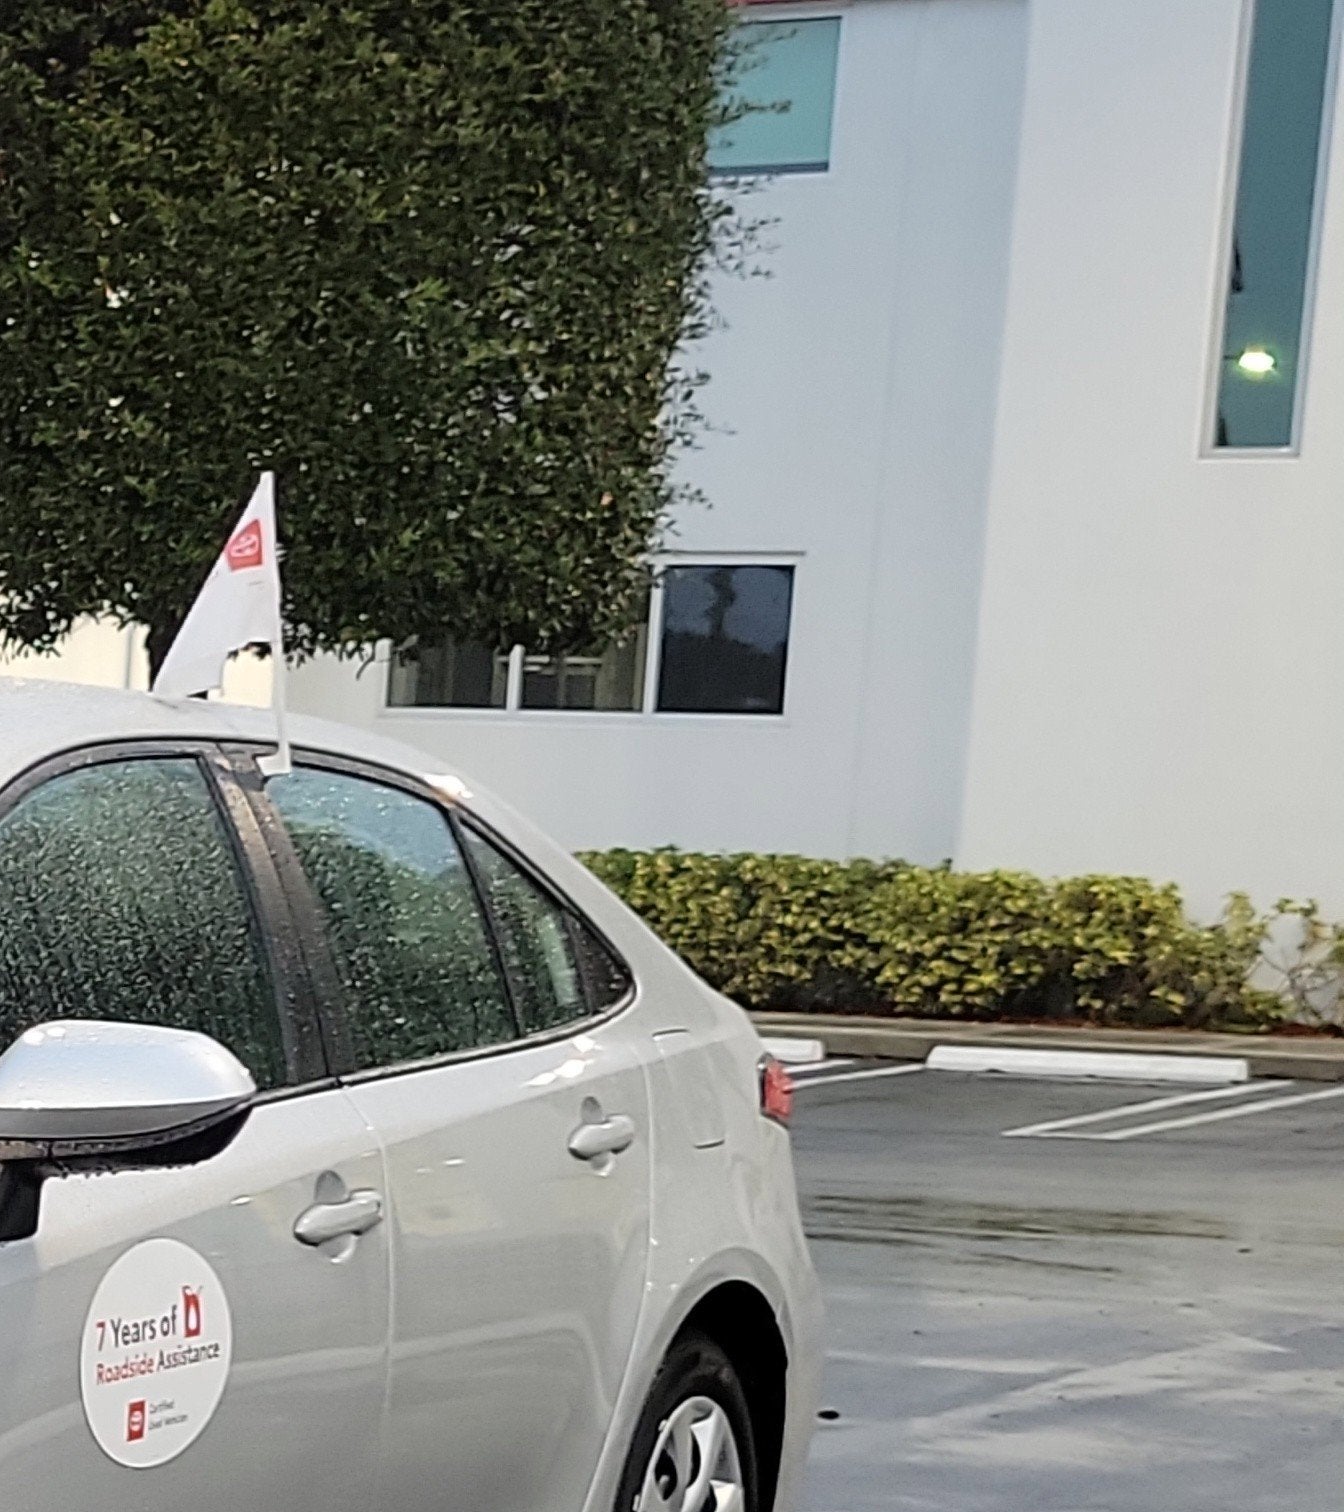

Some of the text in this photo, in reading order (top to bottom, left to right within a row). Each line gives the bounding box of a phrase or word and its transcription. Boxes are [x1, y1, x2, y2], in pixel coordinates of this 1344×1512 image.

[96, 1304, 178, 1351] 7 Years of
[96, 1342, 220, 1385] Roadside Assistance
